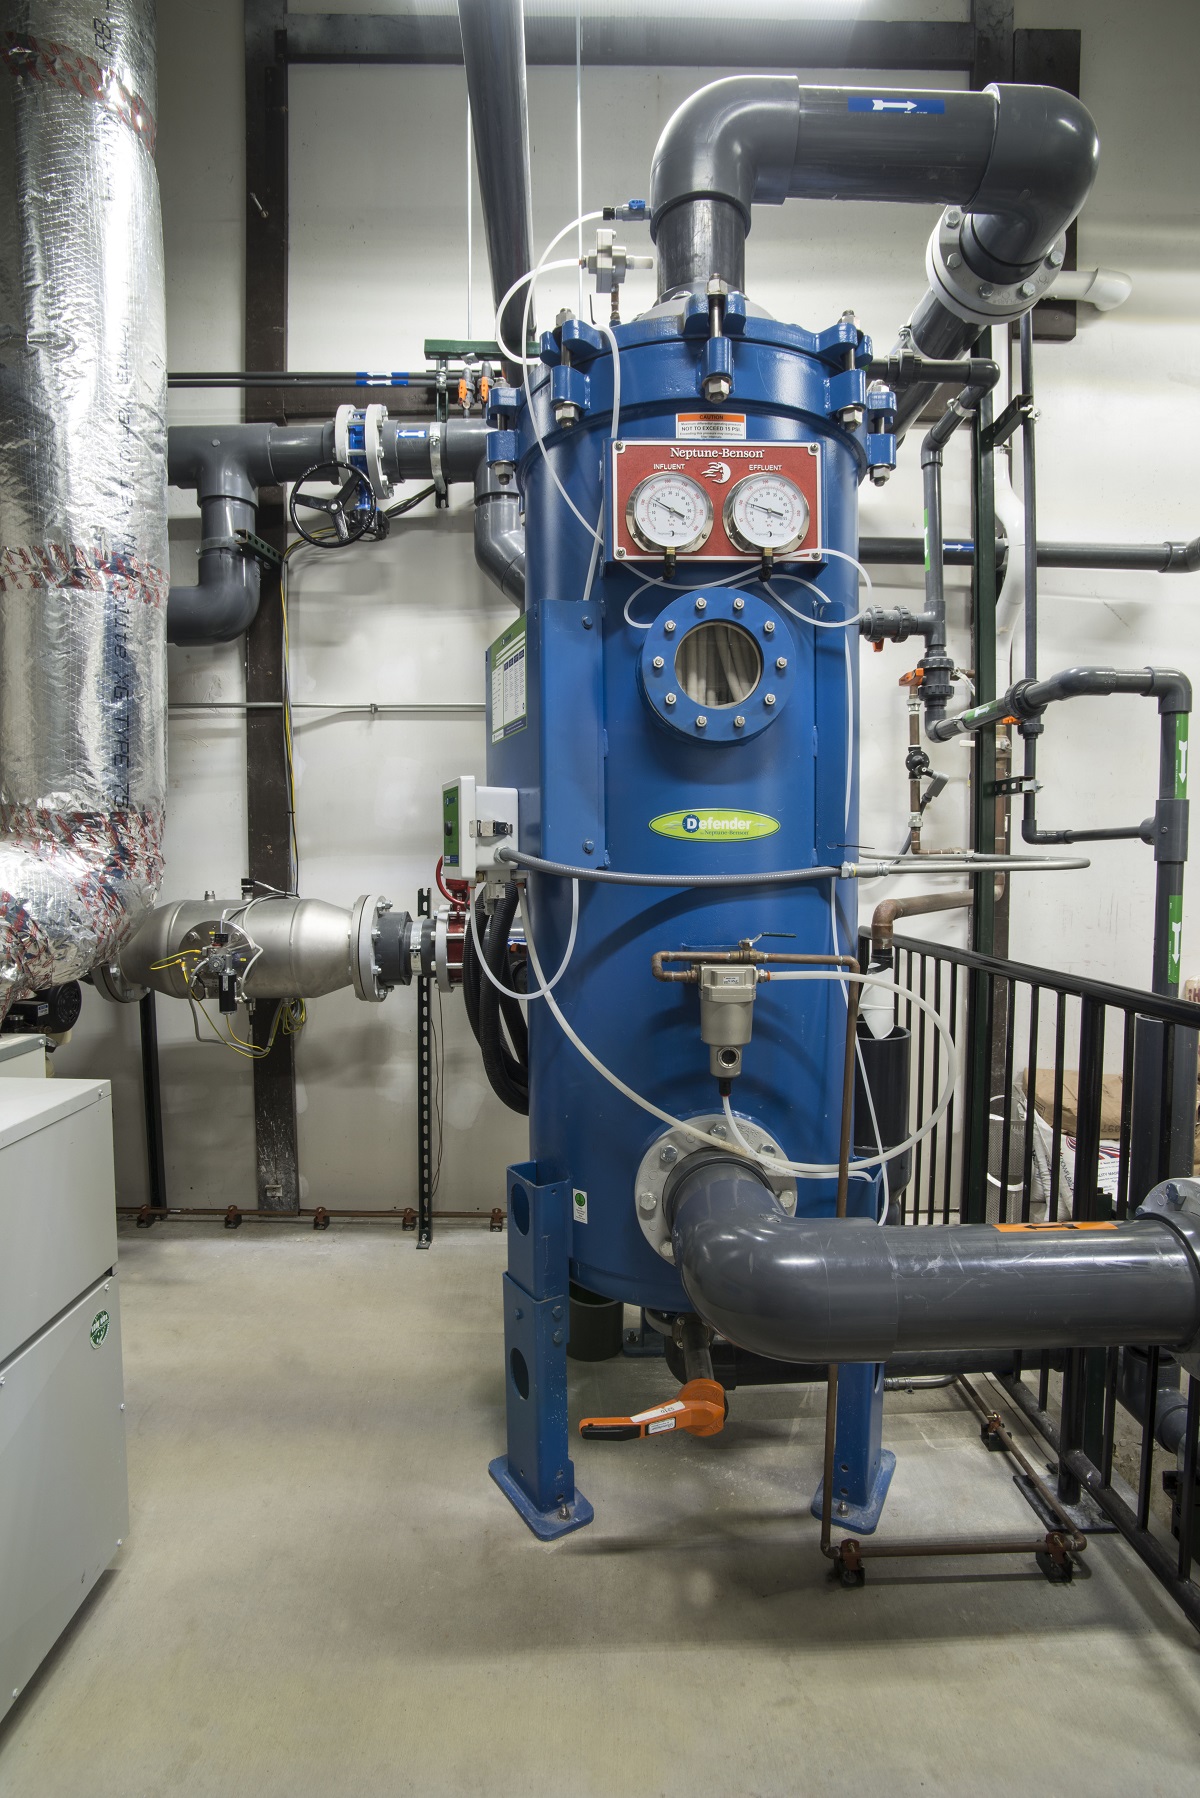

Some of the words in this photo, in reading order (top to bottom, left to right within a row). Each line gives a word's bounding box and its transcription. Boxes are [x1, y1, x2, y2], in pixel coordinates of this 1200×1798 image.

[670, 448, 763, 460] Neptune-Benson
[114, 670, 130, 700] XG
[114, 714, 130, 768] TYPE
[686, 816, 752, 830] Defender
